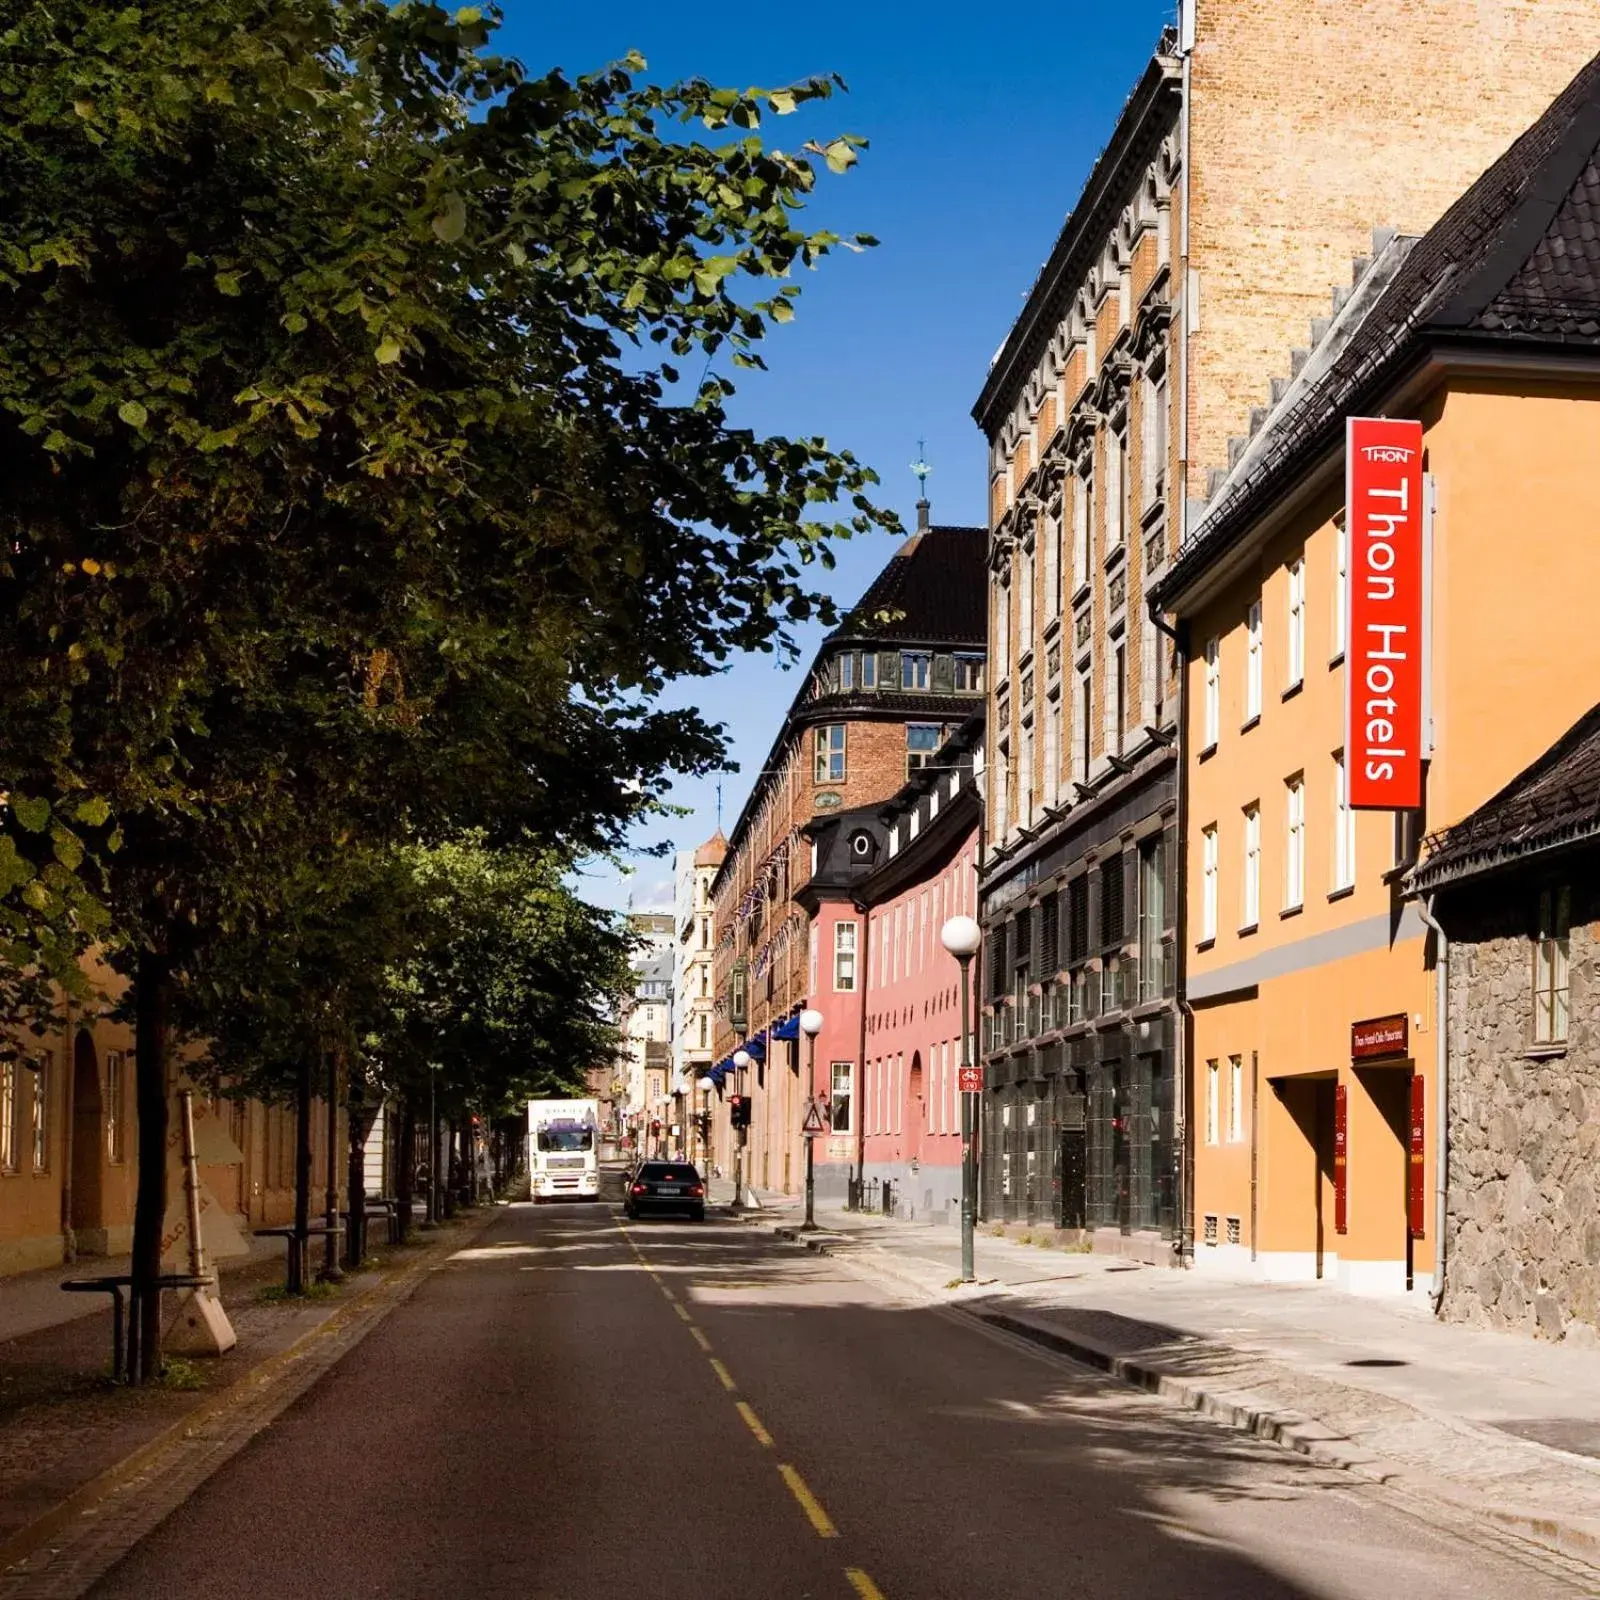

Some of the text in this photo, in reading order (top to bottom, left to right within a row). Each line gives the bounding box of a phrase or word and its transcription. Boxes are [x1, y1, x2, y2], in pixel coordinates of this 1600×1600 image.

[1361, 446, 1415, 463] THON
[1365, 477, 1408, 781] Thon Hotels
